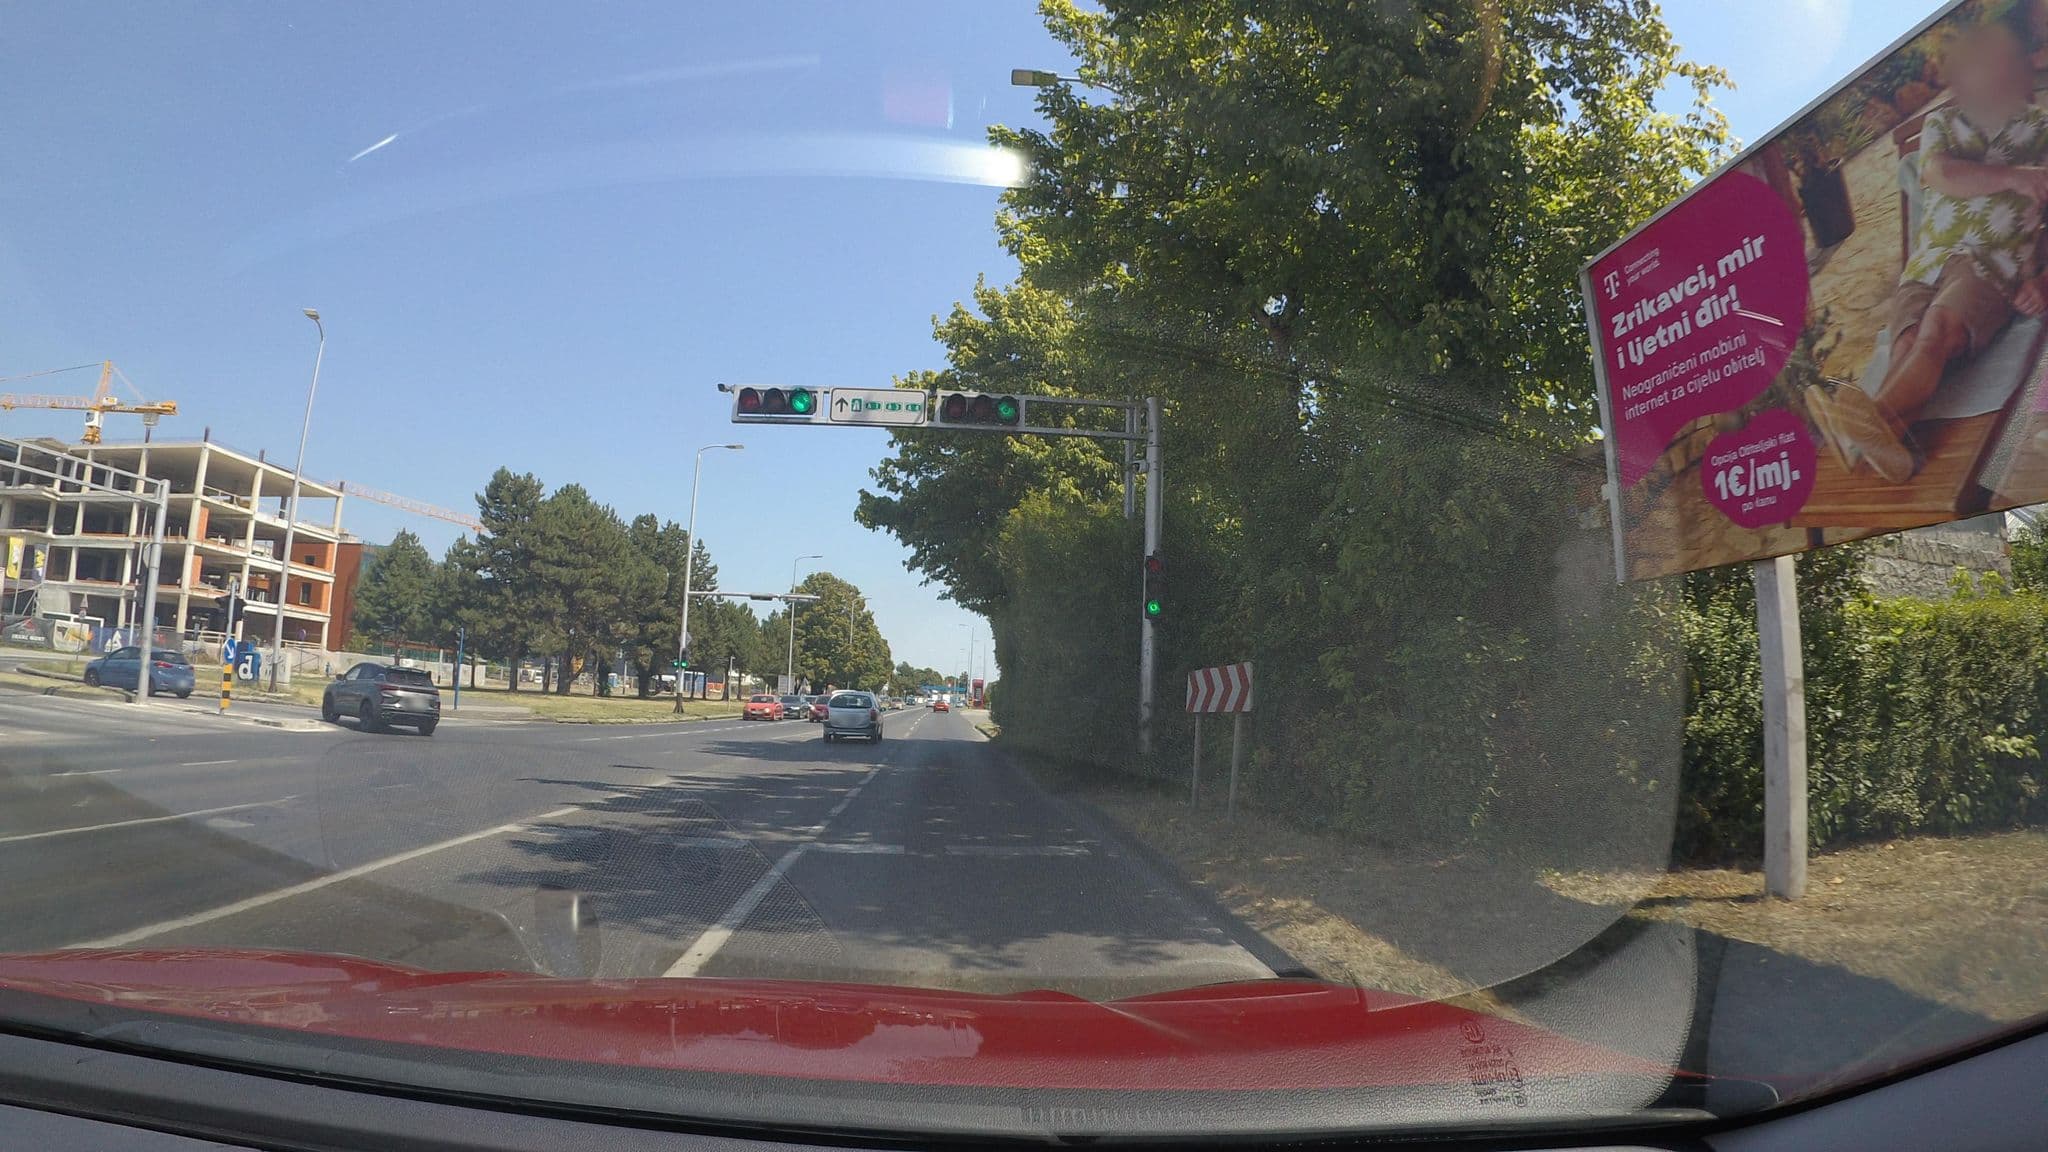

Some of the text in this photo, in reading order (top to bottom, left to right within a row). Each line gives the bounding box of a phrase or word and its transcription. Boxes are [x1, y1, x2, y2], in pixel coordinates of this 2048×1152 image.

[1611, 235, 1765, 339] Zrikavci, mir
[1616, 284, 1741, 370] i ljetni đir!
[1622, 329, 1747, 401] Neograničeni mobilni
[1624, 345, 1766, 421] internet za cijelu obitelj
[1714, 450, 1801, 500] 1€/mj.
